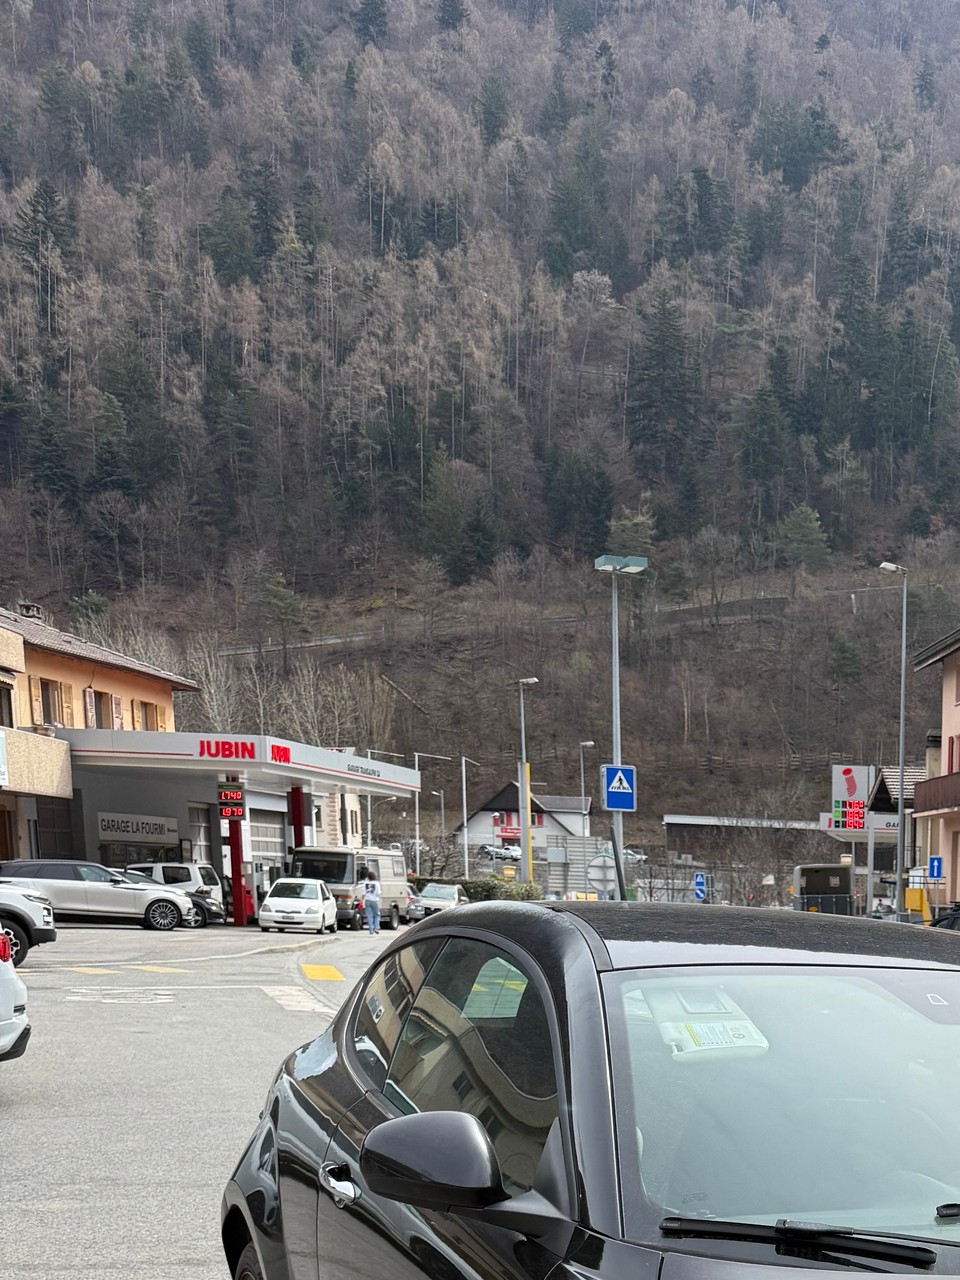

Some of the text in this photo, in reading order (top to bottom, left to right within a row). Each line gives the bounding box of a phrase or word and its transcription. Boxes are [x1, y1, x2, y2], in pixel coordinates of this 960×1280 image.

[199, 740, 256, 759] JUBIN
[100, 818, 131, 833] GARAGE
[131, 821, 141, 834] LA
